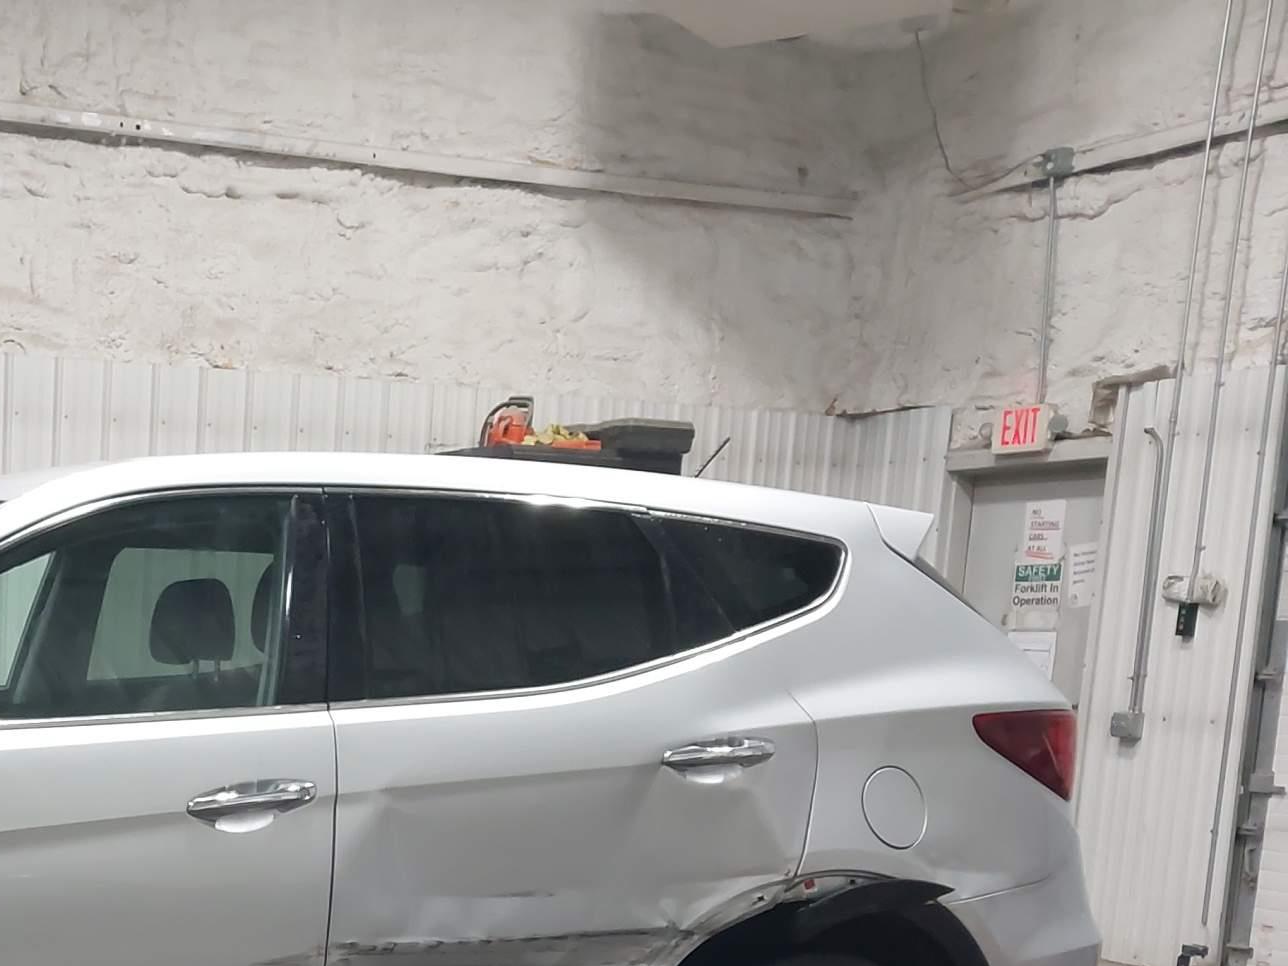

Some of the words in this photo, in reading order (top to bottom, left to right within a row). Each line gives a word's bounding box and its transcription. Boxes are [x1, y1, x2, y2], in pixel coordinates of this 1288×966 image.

[1001, 408, 1040, 446] EXIT
[1018, 565, 1059, 577] SAFETY
[1015, 583, 1048, 593] Forklift
[1050, 583, 1059, 593] In
[1012, 595, 1059, 607] Operation
